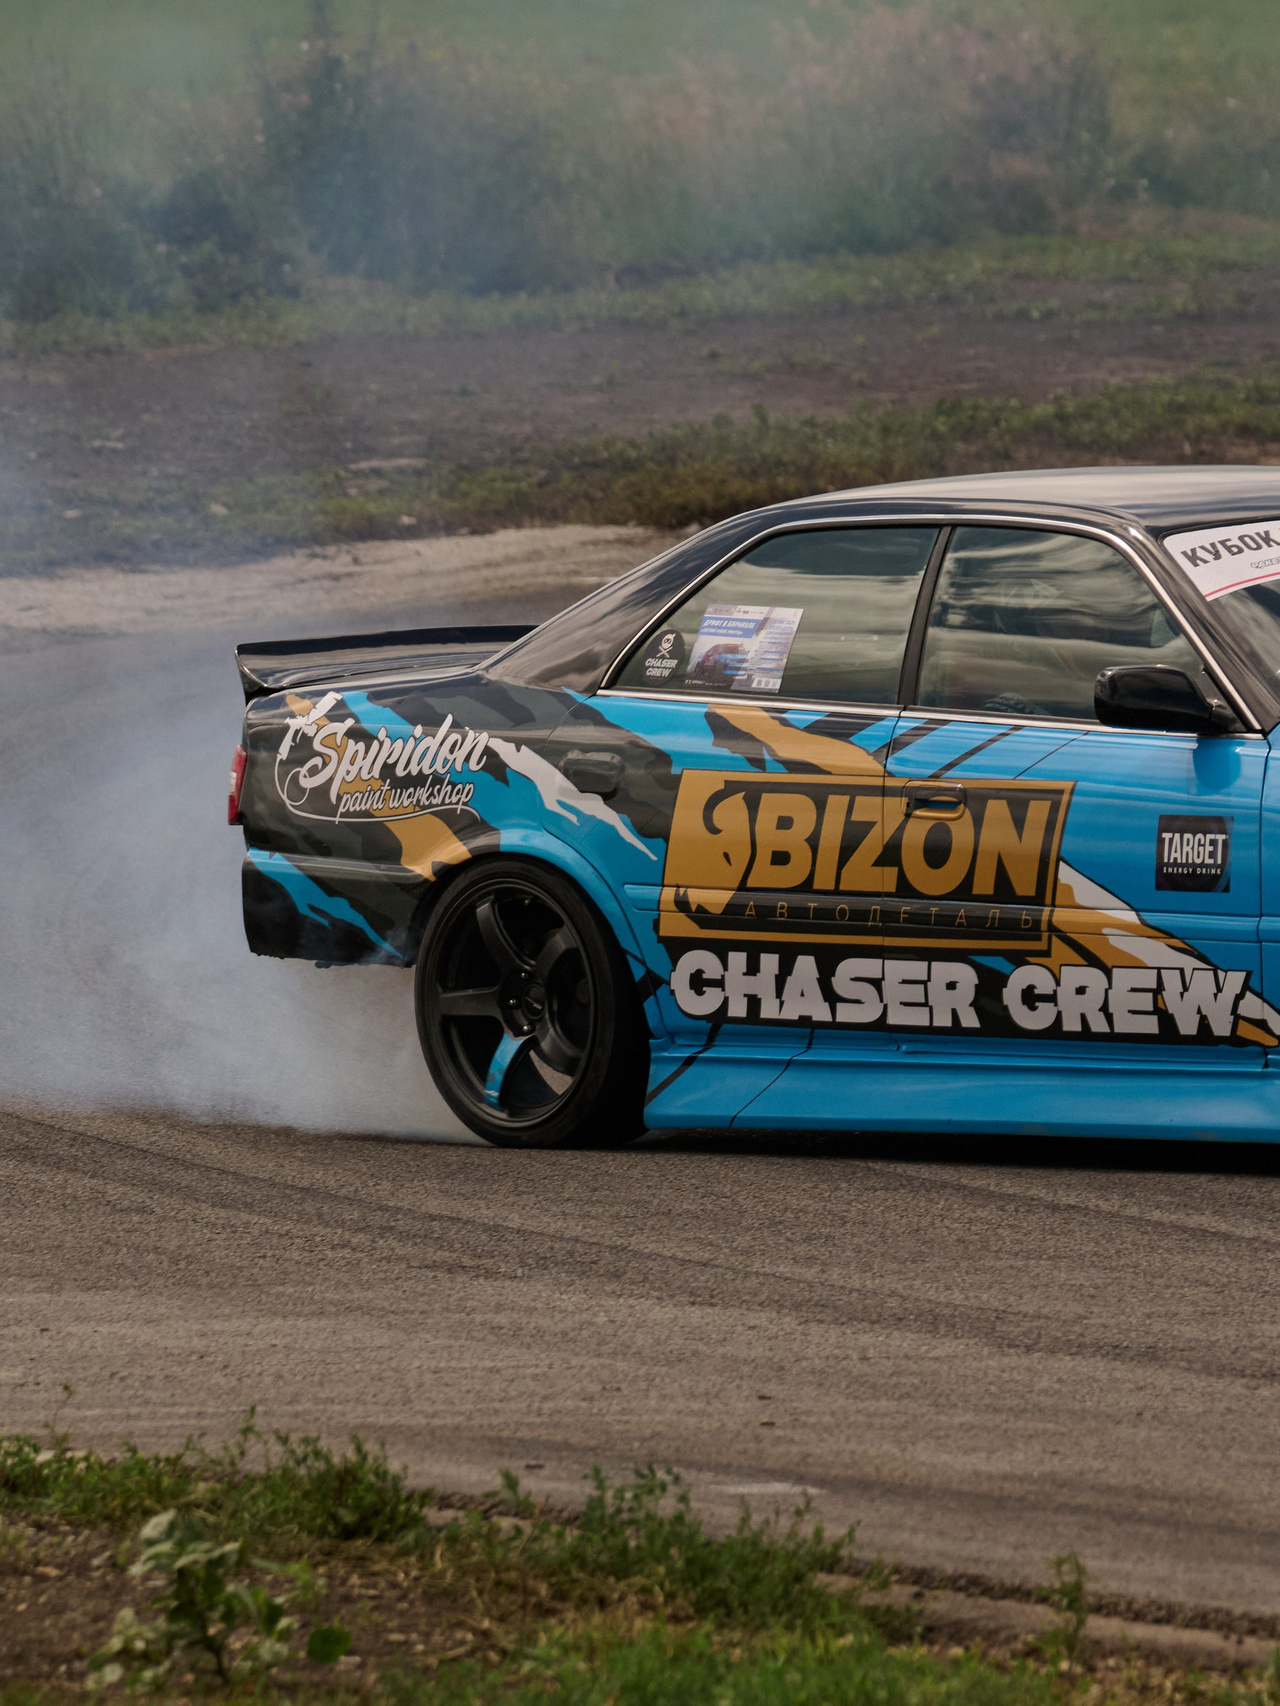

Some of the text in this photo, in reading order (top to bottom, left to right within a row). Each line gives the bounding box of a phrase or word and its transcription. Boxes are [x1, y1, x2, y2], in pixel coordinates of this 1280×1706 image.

[644, 657, 678, 669] CHASER
[645, 667, 673, 678] CREW
[299, 713, 490, 805] Spiridon
[335, 774, 474, 824] paint workshop
[746, 792, 1051, 897] BIZON
[1161, 832, 1227, 865] TARGET
[1163, 866, 1222, 875] ENERGY DRINK
[745, 900, 1033, 929] АВТОДЕТАЛЬ
[670, 949, 1251, 1037] CHASER CREW
